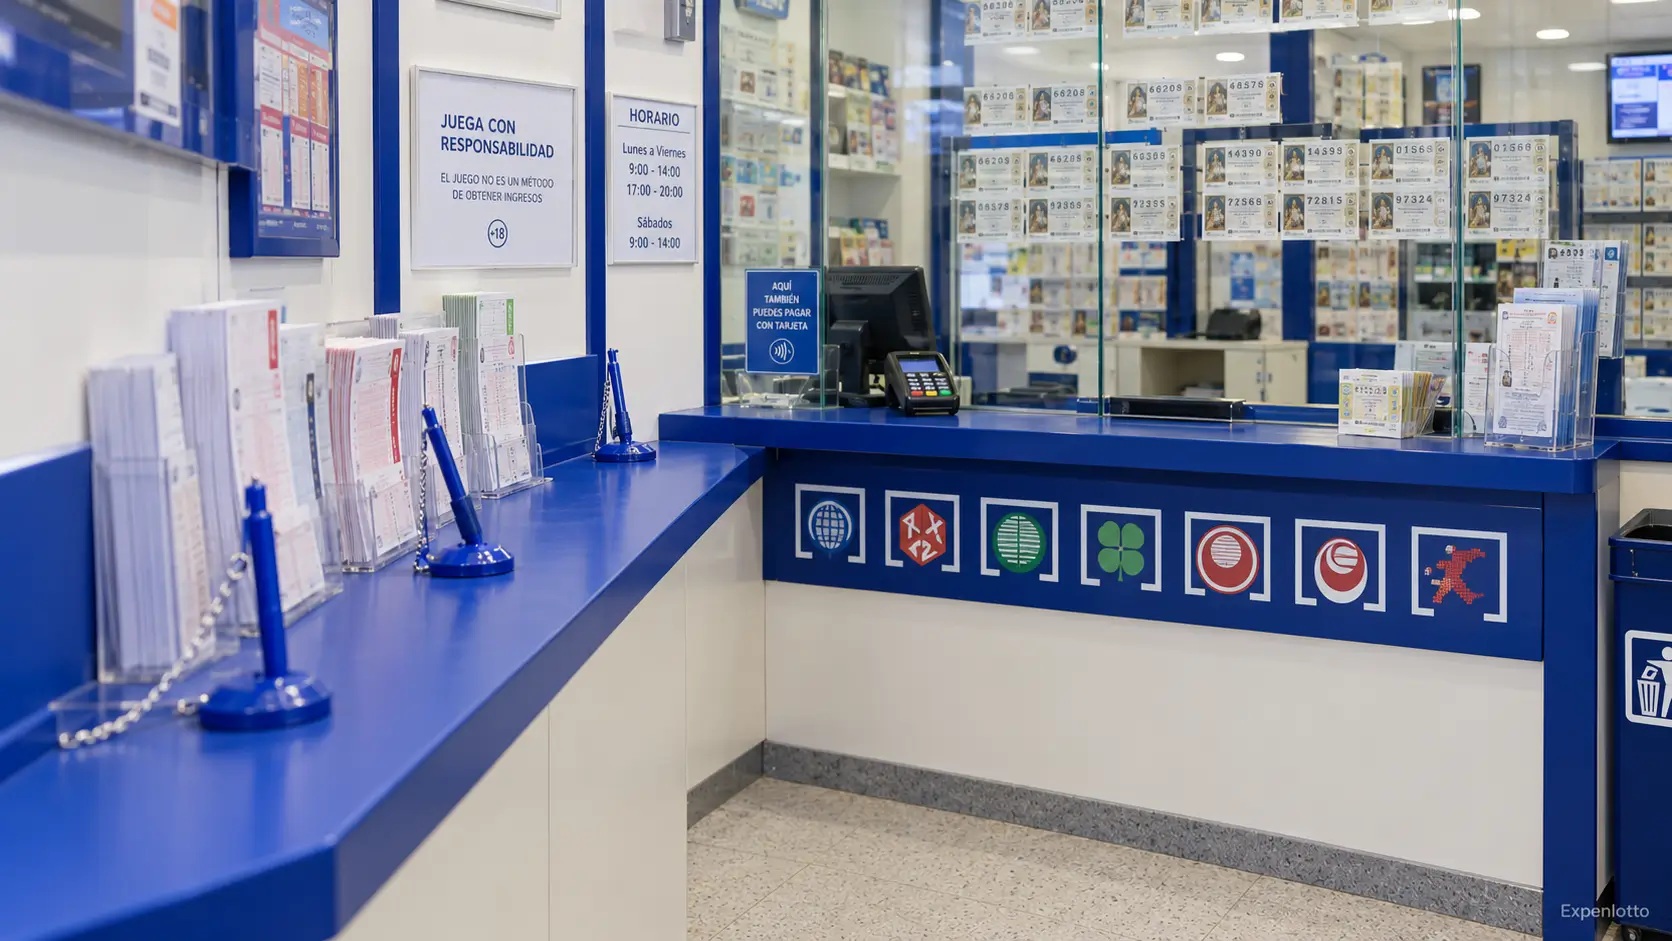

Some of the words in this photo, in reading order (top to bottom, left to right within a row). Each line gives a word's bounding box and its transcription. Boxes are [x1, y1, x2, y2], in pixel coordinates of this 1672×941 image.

[441, 114, 484, 131] JUEGA
[488, 118, 516, 134] CON
[629, 108, 680, 127] HORARIO
[441, 136, 554, 158] RESPONSABILIDAD
[622, 142, 647, 156] Lunes
[649, 147, 655, 156] a
[656, 145, 686, 159] Viernes
[629, 163, 649, 175] 9:00
[658, 165, 681, 177] 14:00
[440, 172, 450, 183] EL
[453, 174, 480, 184] JUEGO
[482, 175, 494, 185] NO
[496, 176, 506, 186] ES
[508, 177, 519, 186] UN
[521, 175, 554, 188] MÉTODO
[452, 189, 463, 200] DE
[465, 190, 502, 201] OBTENER
[505, 192, 543, 203] INGRESOS
[627, 184, 651, 196] 17:00
[660, 185, 683, 198] 20:00
[637, 216, 673, 229] Sábados
[490, 226, 505, 240] +18
[629, 236, 649, 248] 9:00
[658, 236, 681, 249] 14:00
[772, 279, 792, 291] AQUÍ
[764, 294, 800, 304] TAMBIÉN
[752, 308, 783, 317] PUEDES
[784, 308, 811, 317] PAGAR
[756, 321, 773, 330] CON
[775, 321, 808, 330] TARJETA
